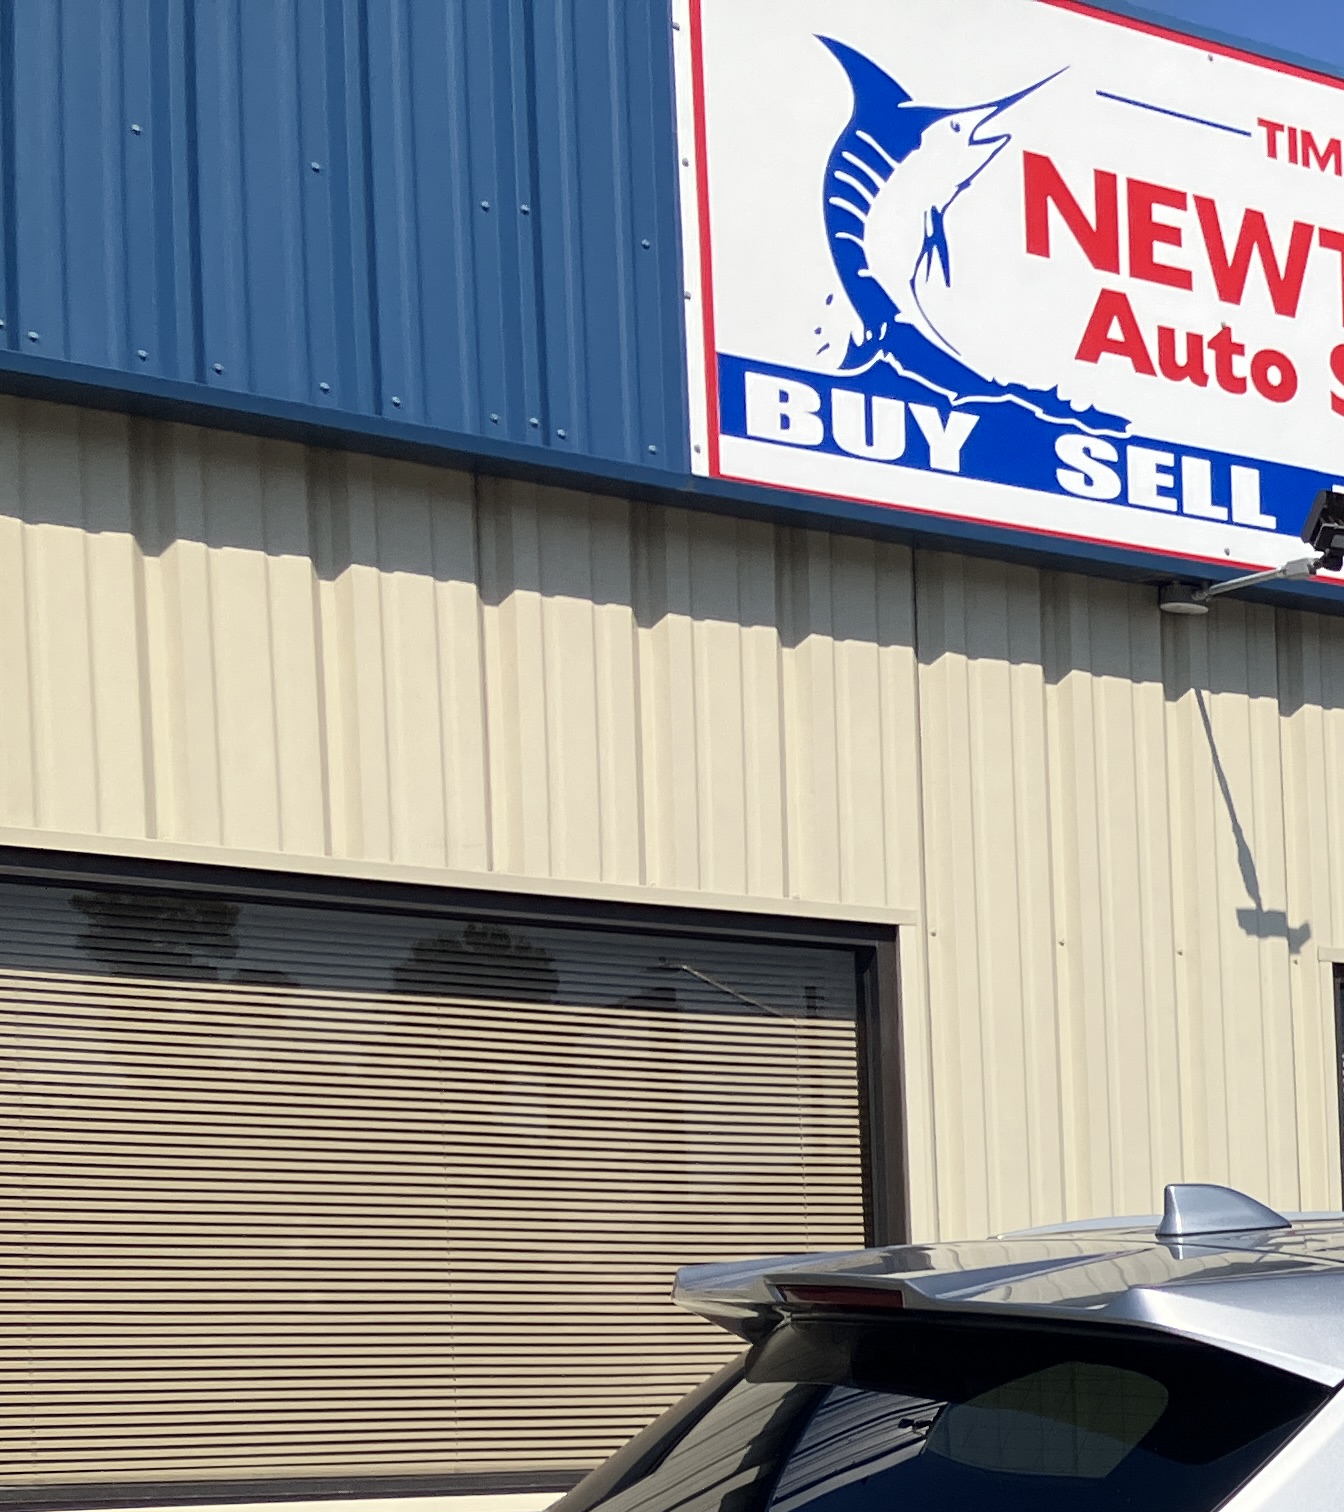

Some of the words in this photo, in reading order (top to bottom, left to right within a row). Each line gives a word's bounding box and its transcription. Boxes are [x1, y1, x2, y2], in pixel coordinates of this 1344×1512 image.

[1257, 116, 1342, 177] TIM
[1075, 287, 1298, 403] Auto
[744, 371, 980, 473] BUY
[1055, 432, 1277, 529] SELL
